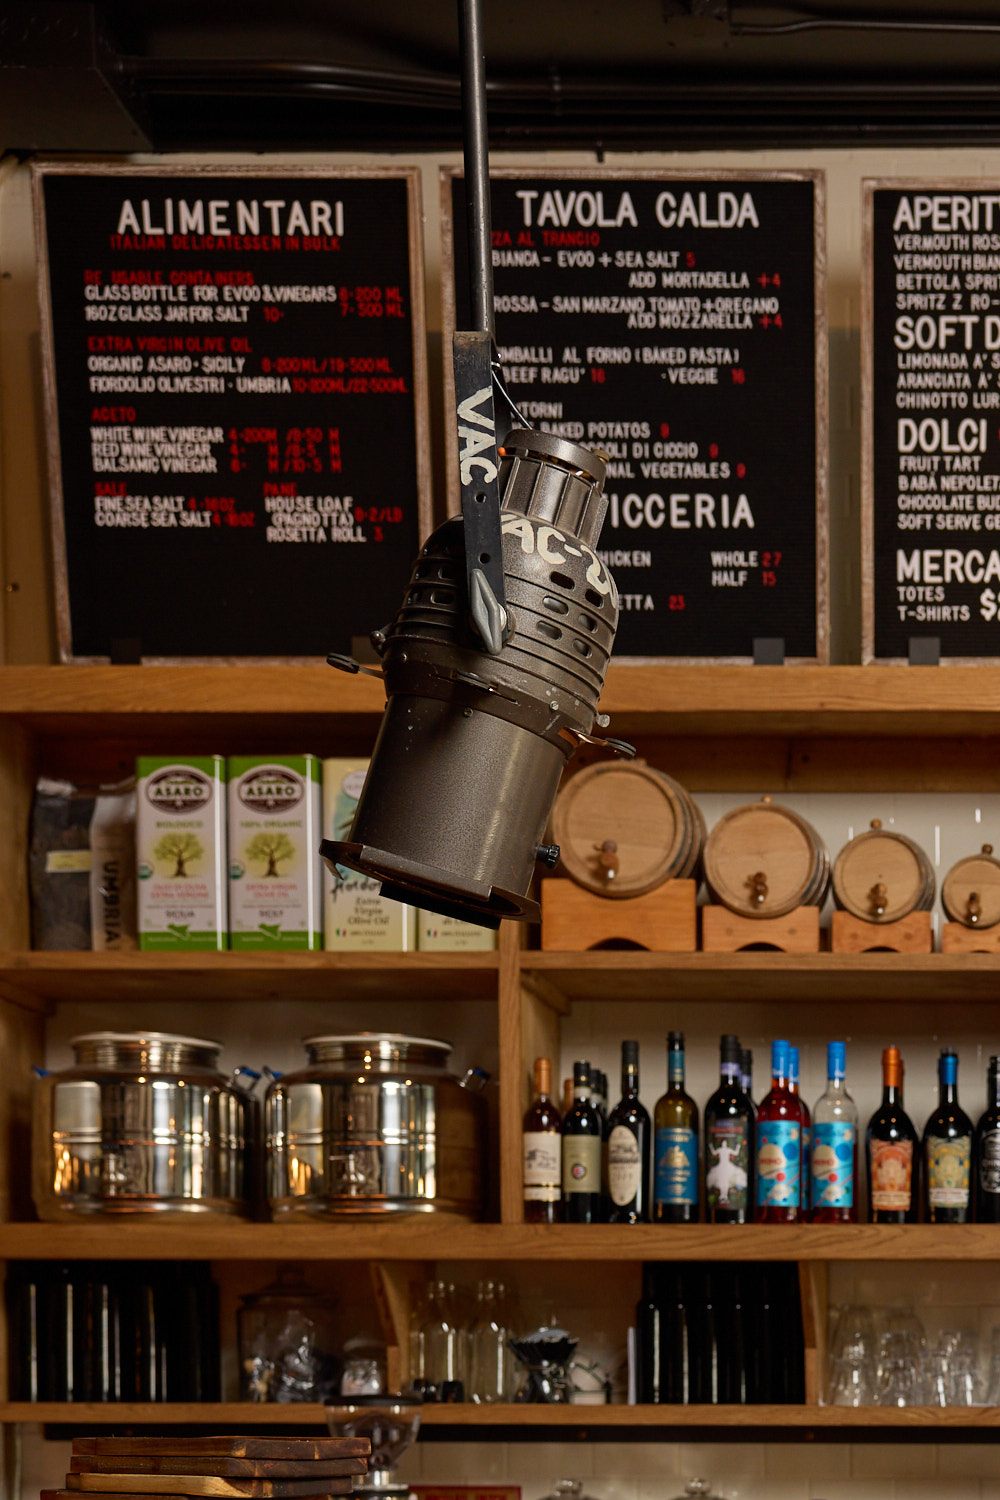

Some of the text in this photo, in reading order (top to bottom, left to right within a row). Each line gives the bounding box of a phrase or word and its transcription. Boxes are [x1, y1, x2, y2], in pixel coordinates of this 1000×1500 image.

[516, 190, 759, 228] TAVOLA CALDA
[118, 199, 343, 239] ALIMENTARI
[111, 233, 165, 249] ITALIAN
[303, 233, 339, 251] BULK
[518, 231, 600, 246] AL TRANCIO
[894, 234, 969, 251] VERMOUTH
[558, 251, 594, 267] EVOO
[615, 251, 643, 267] SEA
[646, 251, 679, 268] SALT
[894, 254, 971, 270] VERMOUTH
[629, 272, 656, 288] ADD
[662, 272, 749, 288] MORTADELLA
[896, 274, 960, 290] BETTOLA
[894, 315, 979, 350] SOFT
[88, 336, 252, 352] EXTRA VIRGIN OLIVE OIL
[668, 368, 717, 384] VEGGIE
[896, 392, 968, 409] CHINOTTO
[92, 407, 136, 422] ACETO
[457, 385, 497, 484] VAC
[898, 418, 987, 452] DOLCI
[900, 456, 981, 471] FRUIT TART
[898, 494, 974, 510] CHOCOLATE
[898, 514, 933, 530] SOFT
[936, 514, 981, 531] SERVE
[712, 571, 747, 586] HALF
[897, 586, 944, 602] TOTES
[898, 605, 970, 621] T-SHIRTS
[155, 786, 203, 796] ASARO
[247, 786, 295, 796] ASARO
